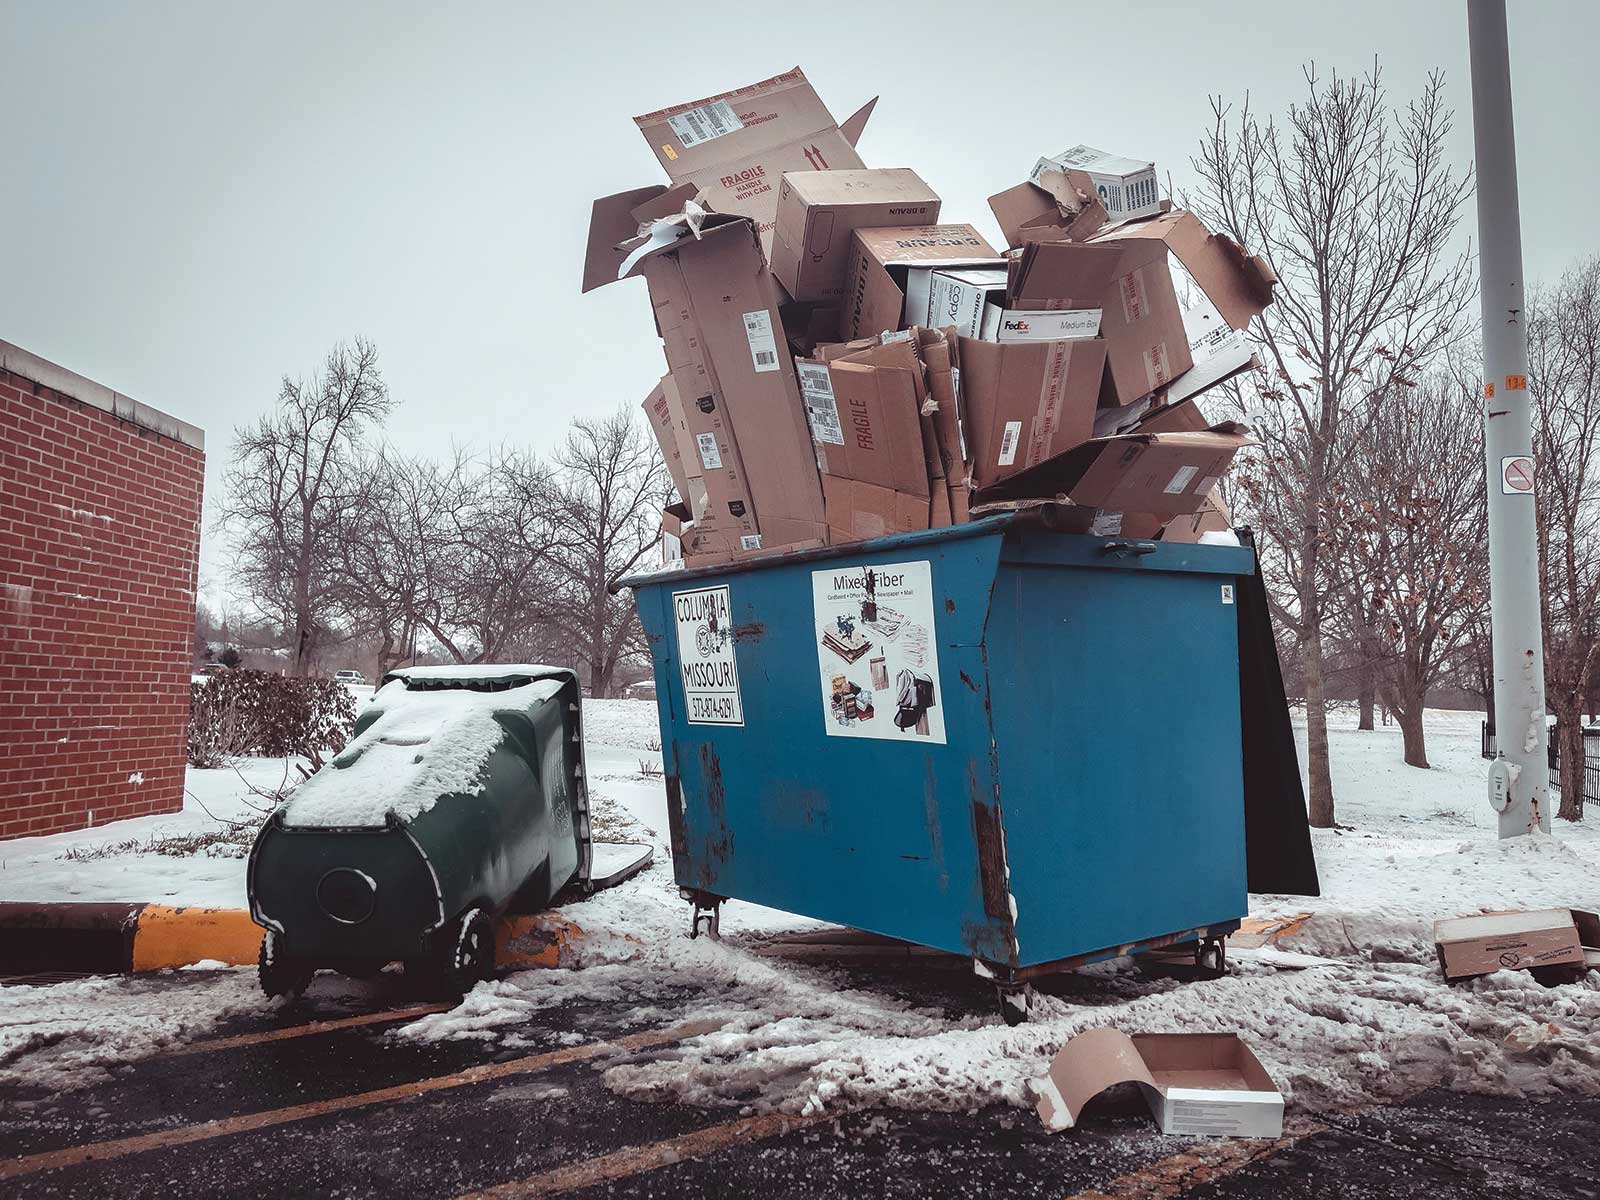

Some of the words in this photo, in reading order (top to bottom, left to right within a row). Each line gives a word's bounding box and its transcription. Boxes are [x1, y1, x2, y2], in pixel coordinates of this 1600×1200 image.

[720, 165, 766, 187] FRAGILE
[735, 178, 763, 193] HANDLE
[735, 188, 754, 201] WITH
[754, 183, 772, 196] CARE
[948, 286, 961, 322] copy
[972, 292, 982, 319] Office
[1004, 320, 1030, 331] FedEx
[1060, 321, 1085, 330] Medium
[1086, 320, 1097, 329] Box
[849, 398, 874, 451] FRAGILE
[873, 572, 905, 588] Fiber
[683, 662, 735, 687] MISSOURI
